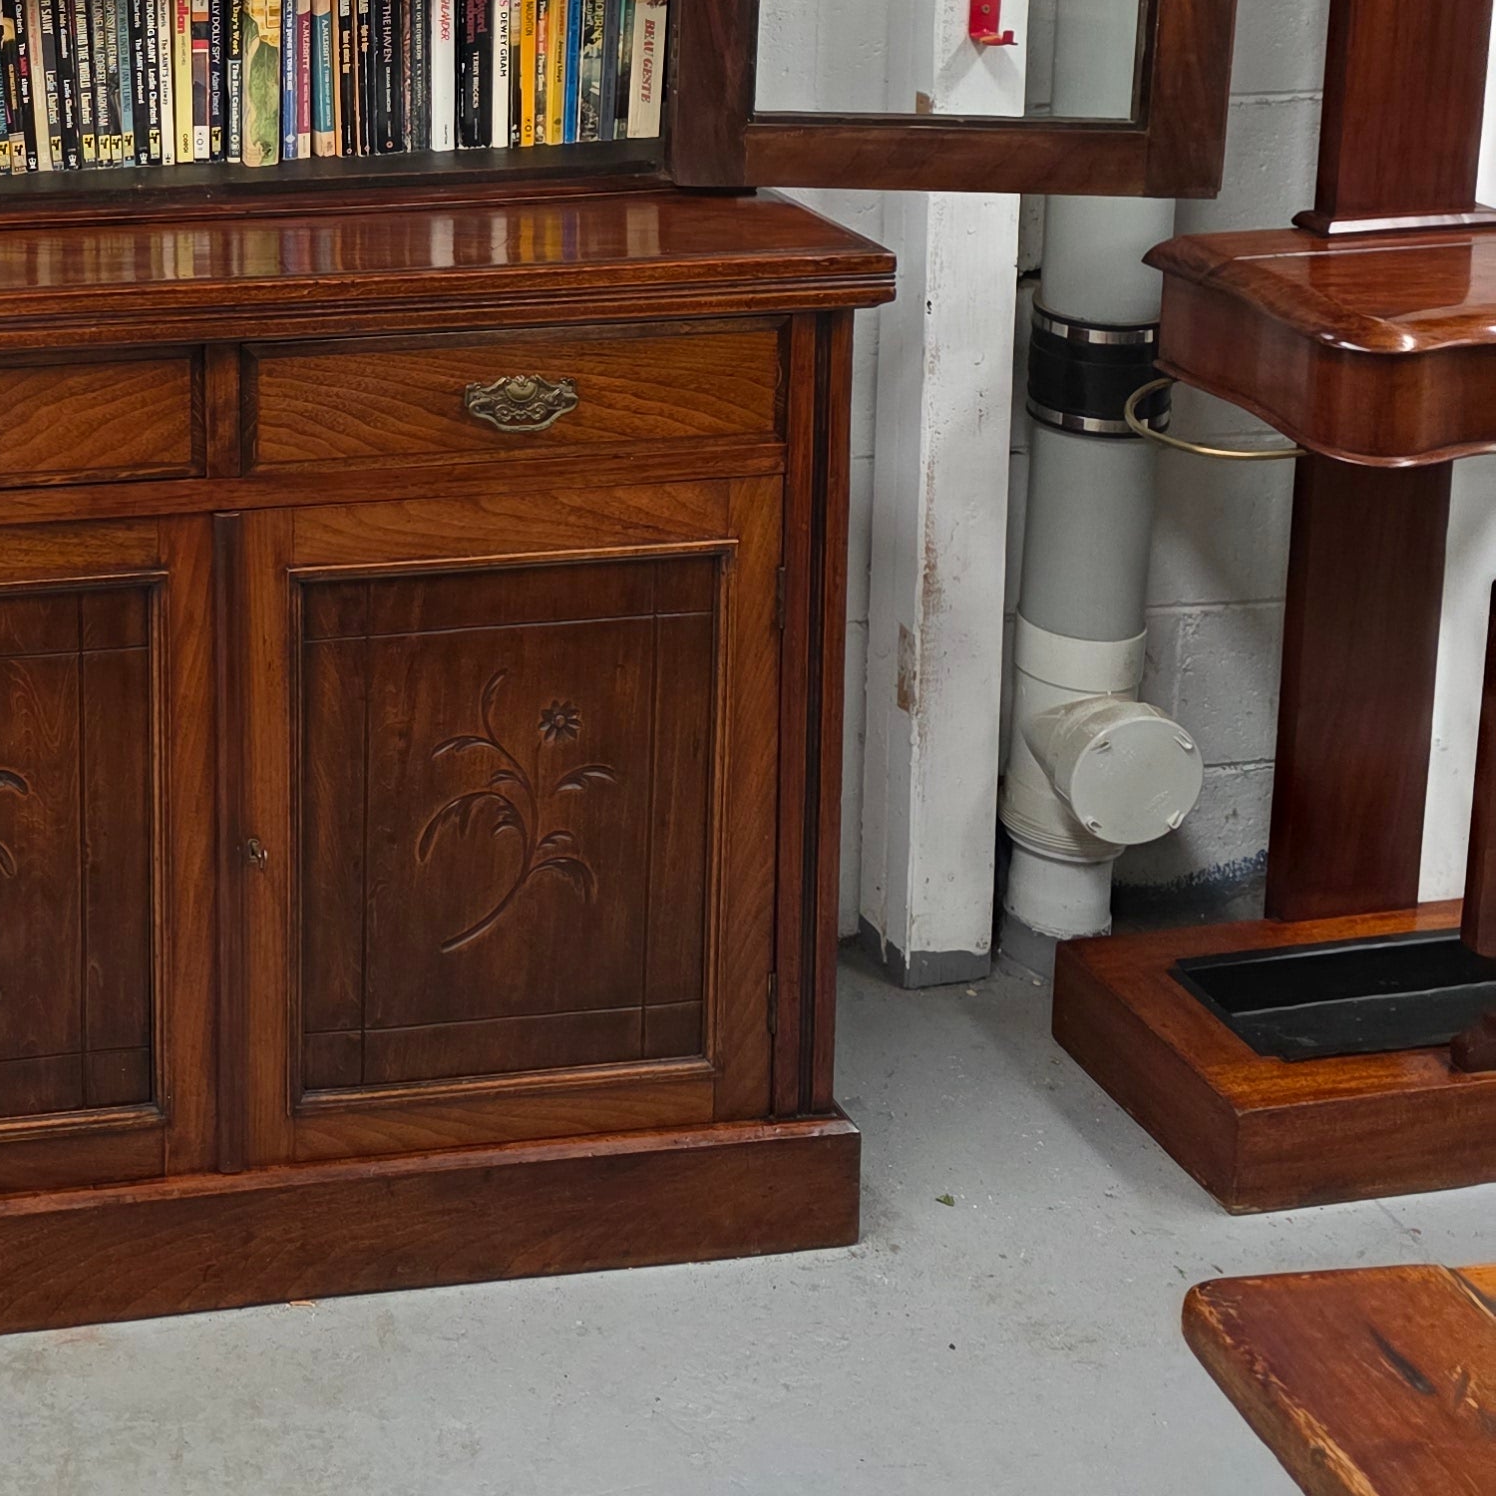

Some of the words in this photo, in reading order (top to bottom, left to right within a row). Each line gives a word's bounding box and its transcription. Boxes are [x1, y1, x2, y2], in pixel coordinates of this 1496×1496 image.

[382, 5, 391, 25] THE
[500, 12, 508, 46] DEWEY
[212, 17, 220, 45] DOLLY
[382, 27, 392, 63] HAVEN
[644, 19, 656, 57] BEAU
[212, 47, 220, 64] SPY
[500, 49, 508, 77] GRAM
[641, 59, 654, 104] GESTE
